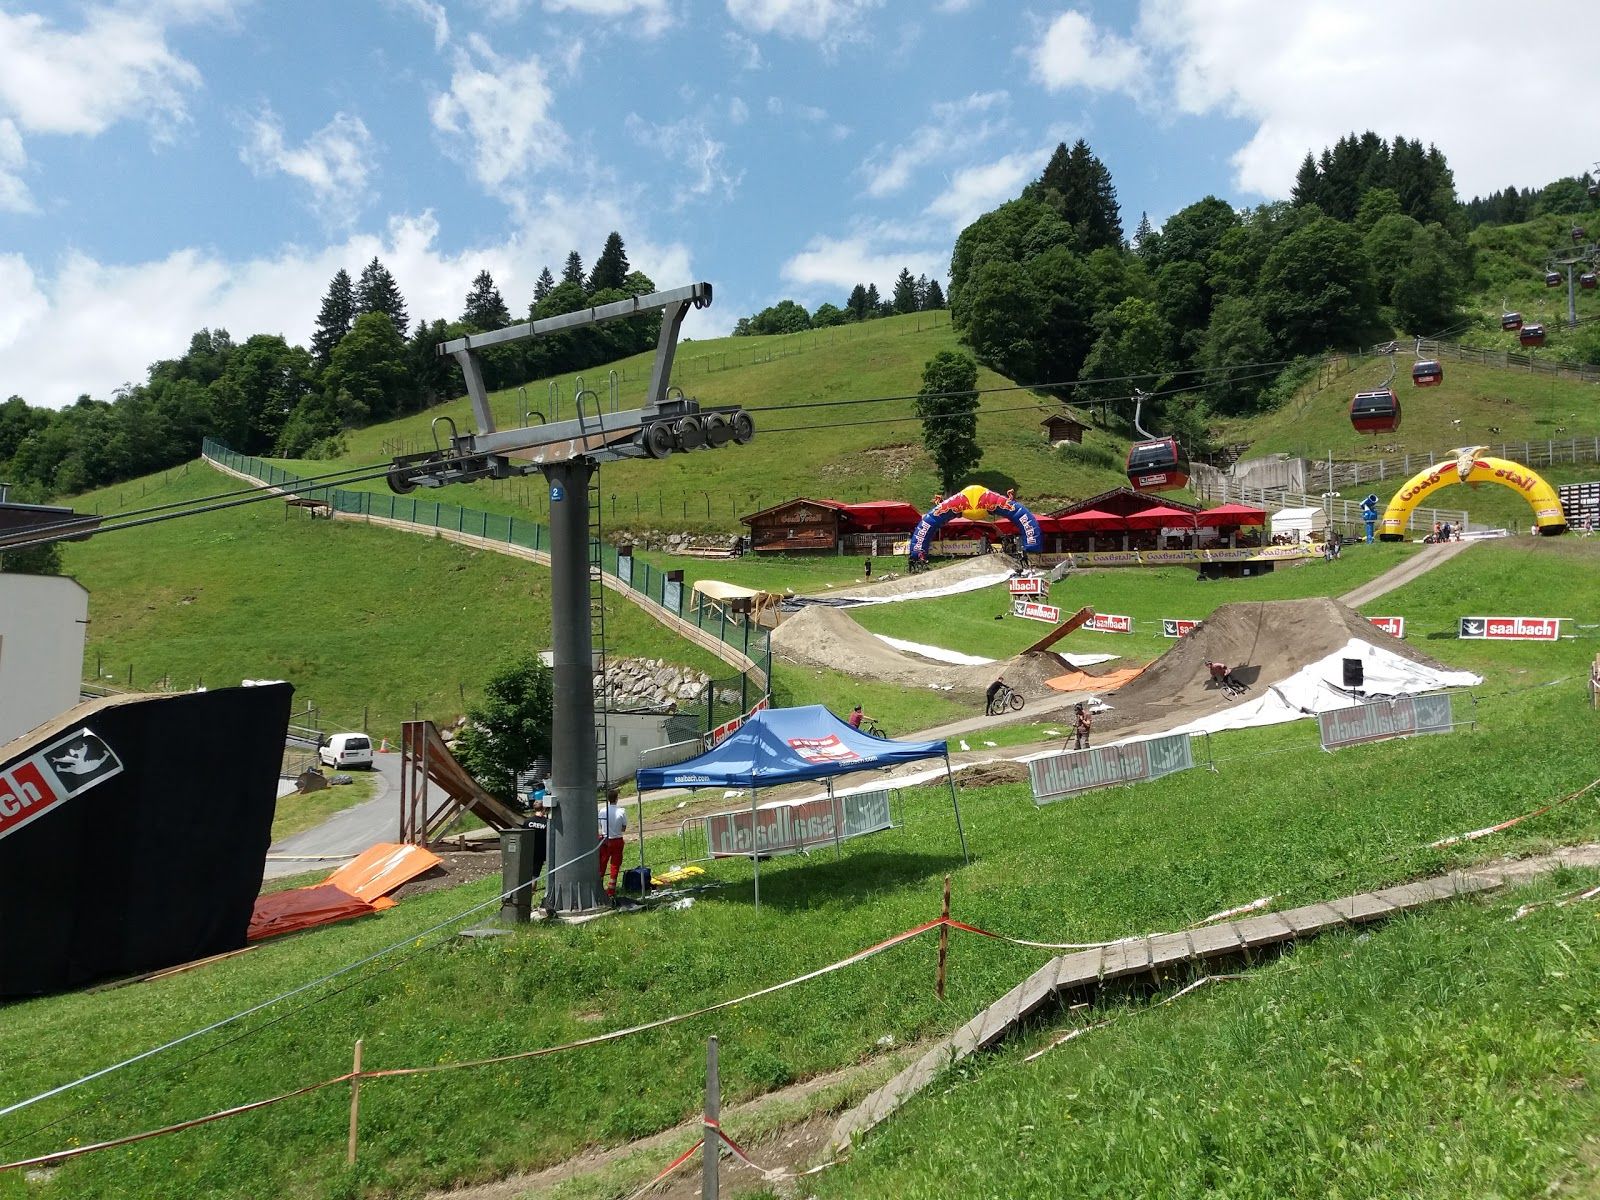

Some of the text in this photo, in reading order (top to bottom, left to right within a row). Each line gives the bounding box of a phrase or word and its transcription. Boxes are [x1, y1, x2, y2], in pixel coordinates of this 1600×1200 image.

[552, 487, 559, 497] 2
[1025, 604, 1057, 620] saalbach
[1095, 615, 1127, 630] saalbach
[1489, 618, 1552, 636] saalbach
[674, 774, 711, 783] saalbach.com
[528, 821, 547, 830] CREW
